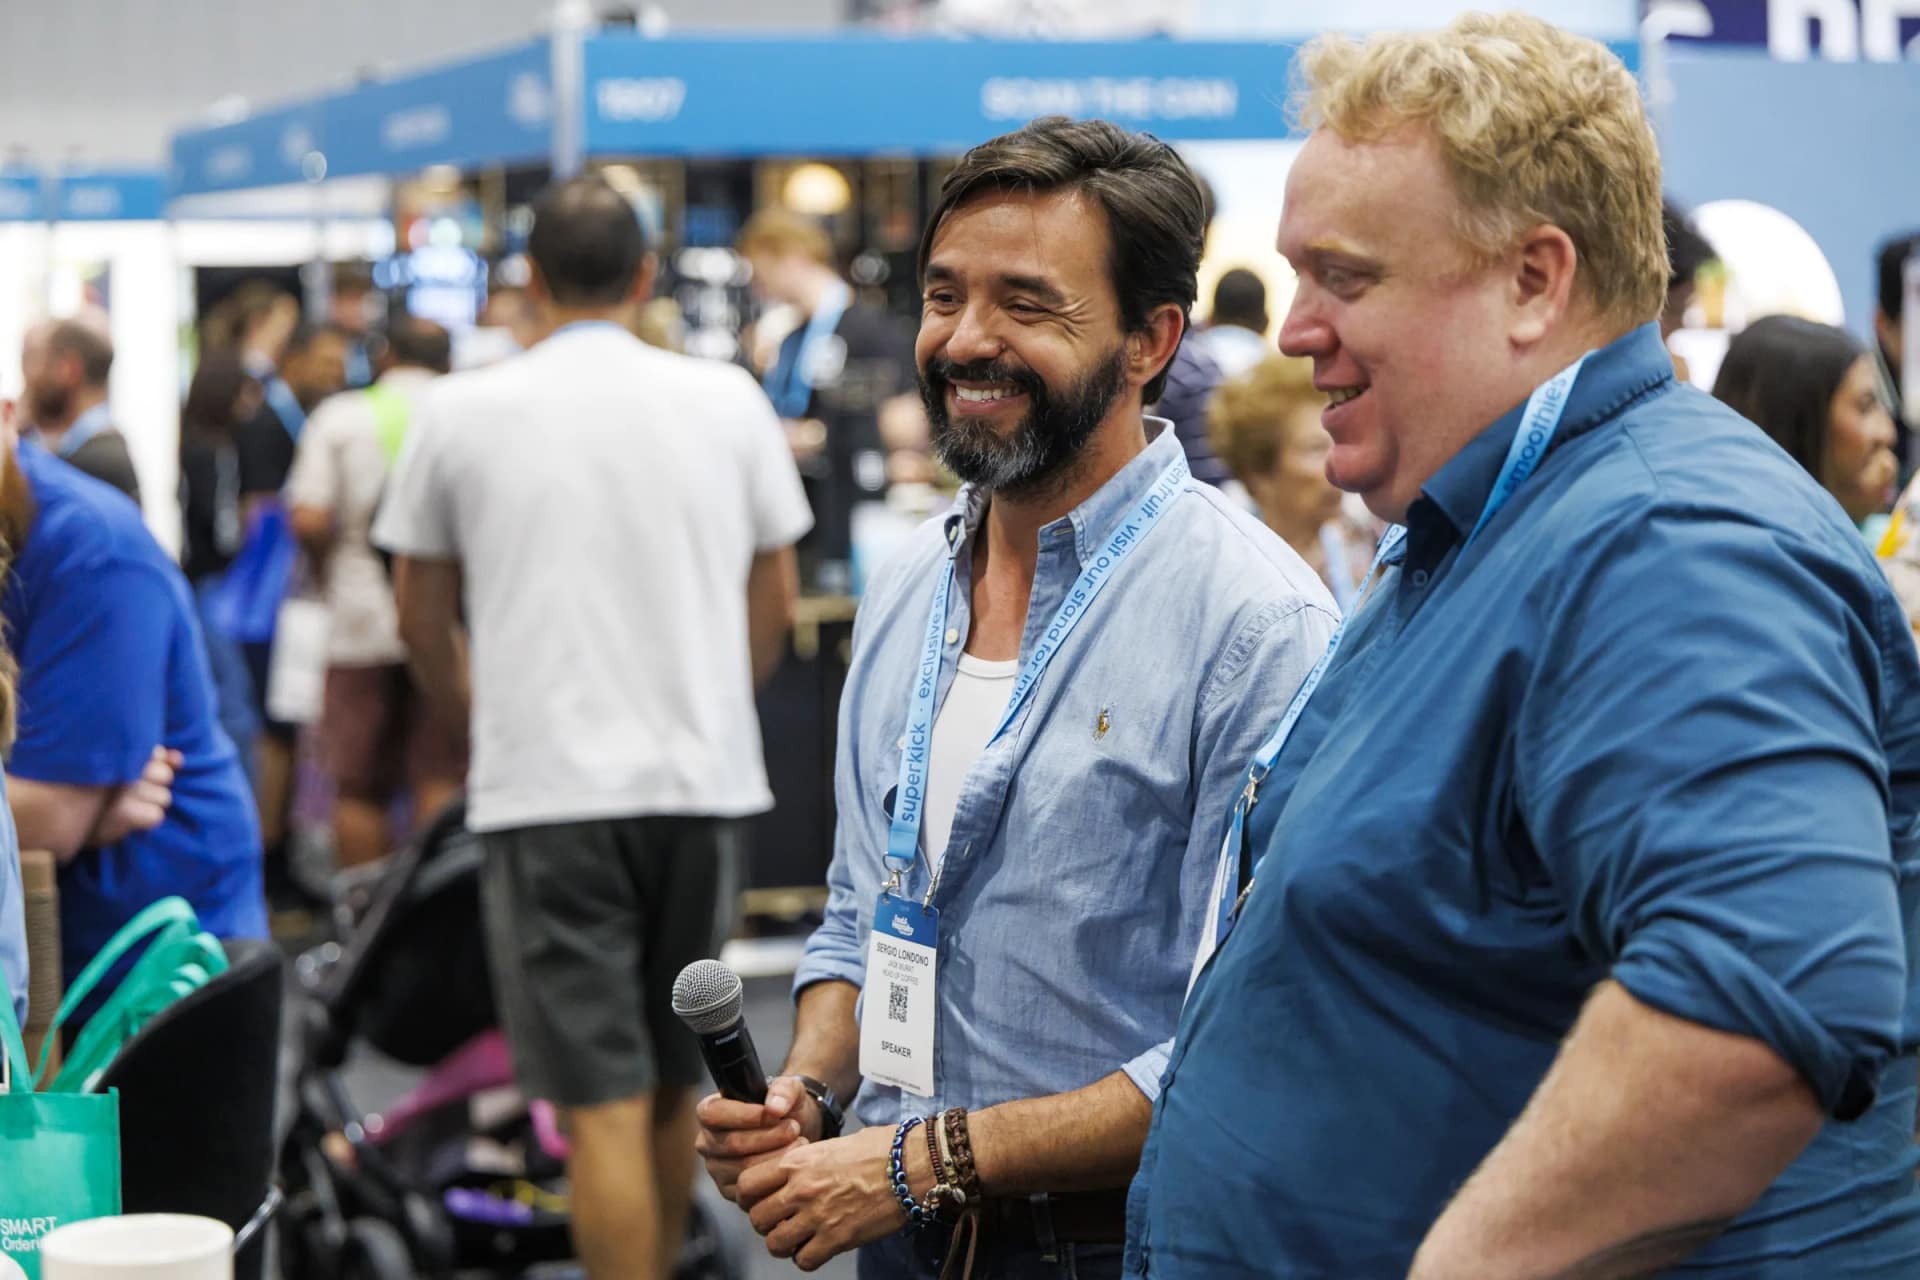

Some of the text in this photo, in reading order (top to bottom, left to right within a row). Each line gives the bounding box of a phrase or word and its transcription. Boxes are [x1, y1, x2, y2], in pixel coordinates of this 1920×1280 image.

[1503, 377, 1567, 492] smoothies
[1141, 481, 1175, 519] fruit
[1112, 523, 1139, 557] visit
[1083, 557, 1110, 589] our
[1048, 591, 1086, 643] stand
[1030, 642, 1054, 672] for
[901, 611, 942, 823] superkick exclusive
[876, 942, 898, 958] SERGIO
[881, 1040, 912, 1059] SPEAKER
[0, 1216, 57, 1236] SMART
